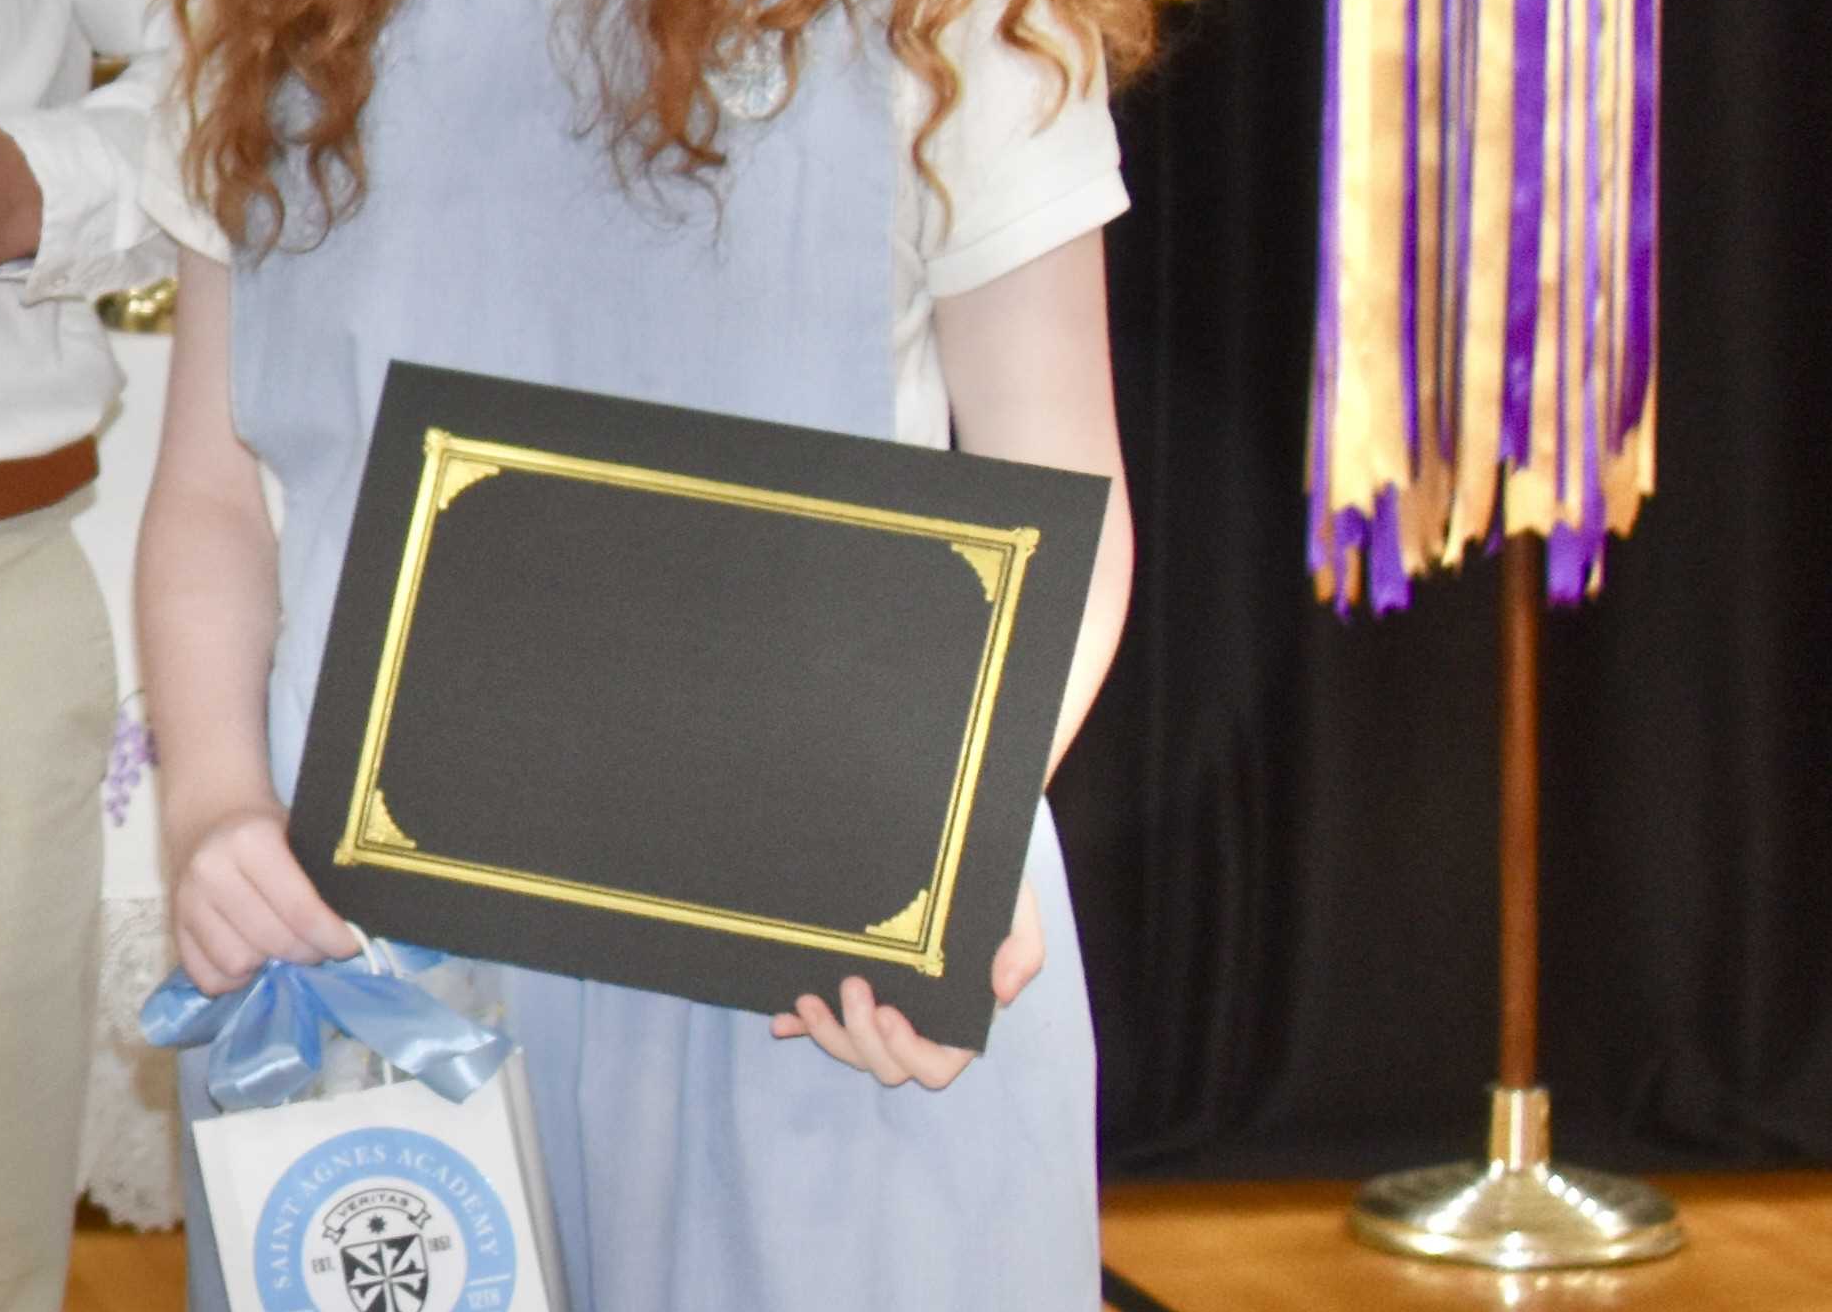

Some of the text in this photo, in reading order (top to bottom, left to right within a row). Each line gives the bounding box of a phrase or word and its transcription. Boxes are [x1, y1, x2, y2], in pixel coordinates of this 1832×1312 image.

[269, 1144, 499, 1291] SAINT AGNES ACADEMY
